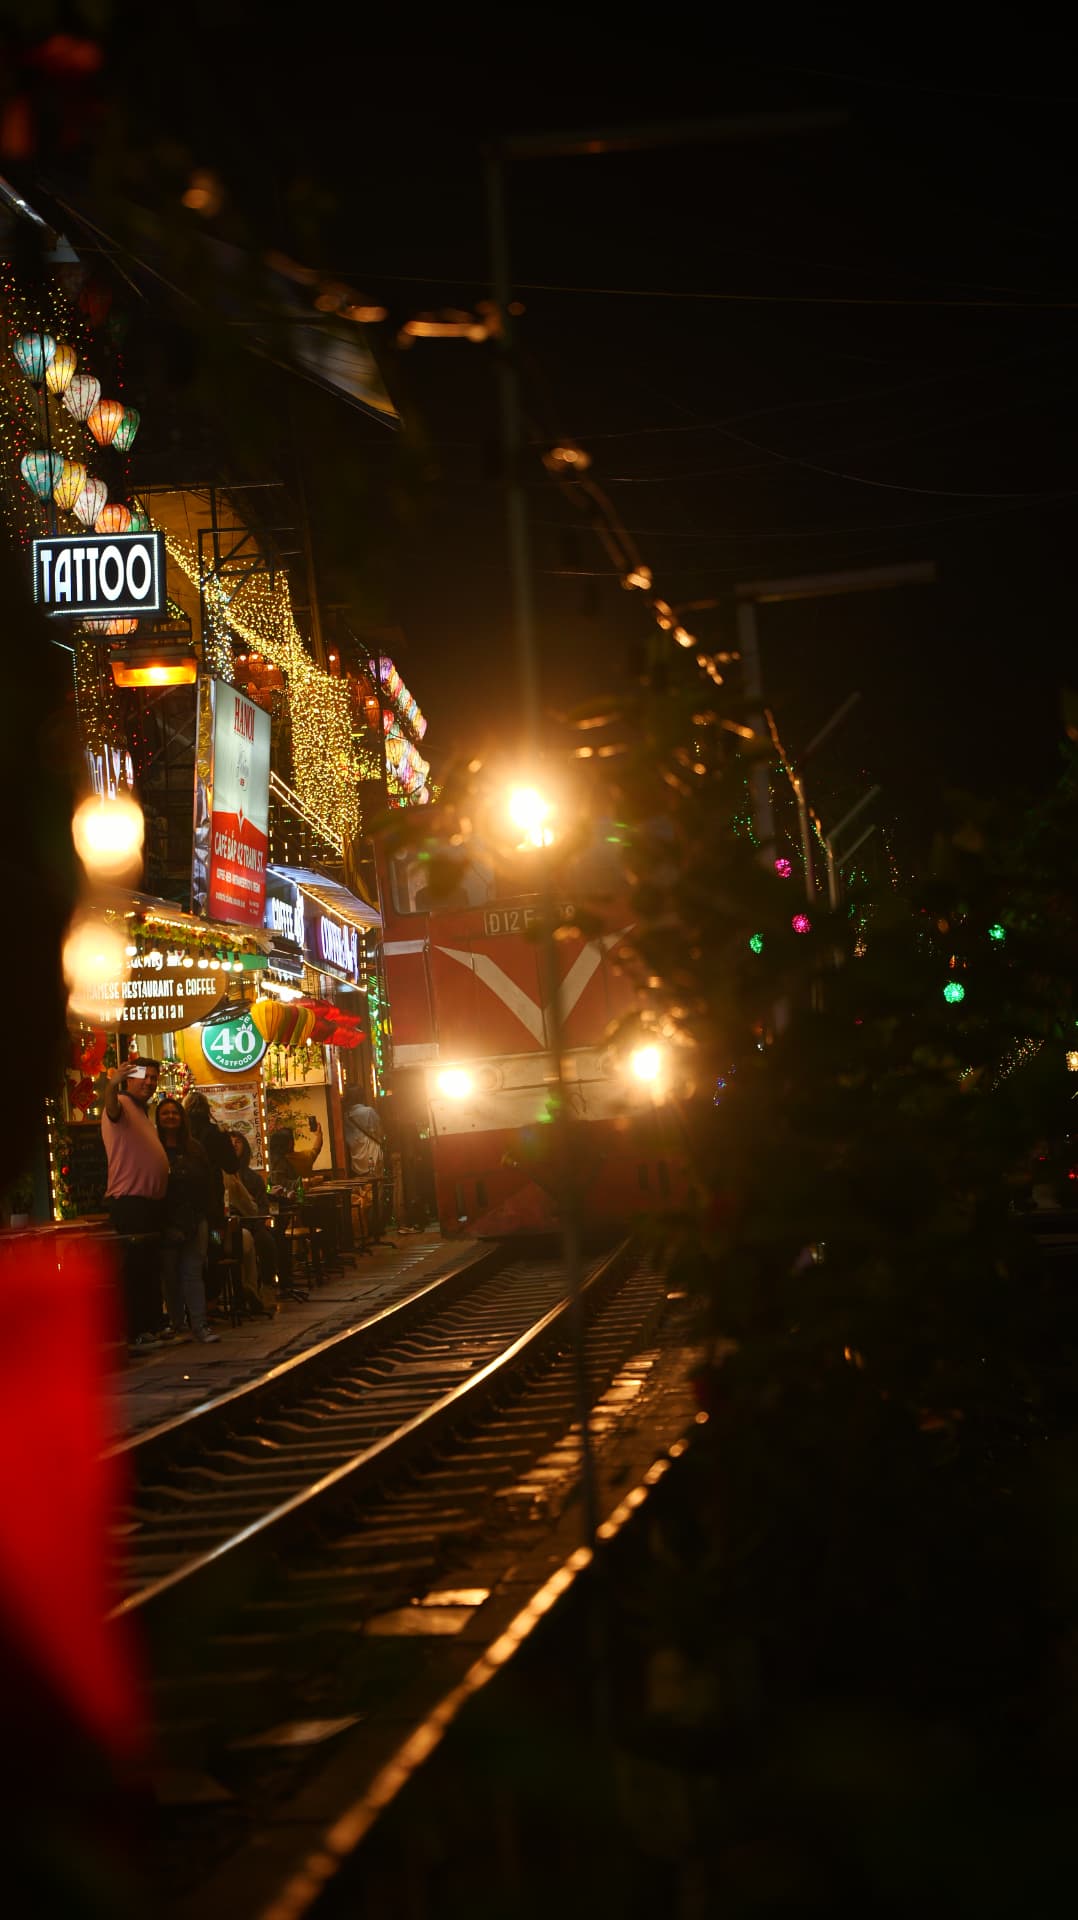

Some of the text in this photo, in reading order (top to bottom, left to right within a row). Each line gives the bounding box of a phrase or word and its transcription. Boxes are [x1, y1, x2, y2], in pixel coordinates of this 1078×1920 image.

[41, 544, 151, 603] TATTOO
[122, 979, 174, 999] RESTAURANT
[176, 982, 184, 996] &
[185, 977, 216, 995] COFFEE
[210, 1028, 256, 1055] 40
[215, 1054, 253, 1067] FASTFOOD
[252, 1092, 263, 1168] VEGETARIAN
